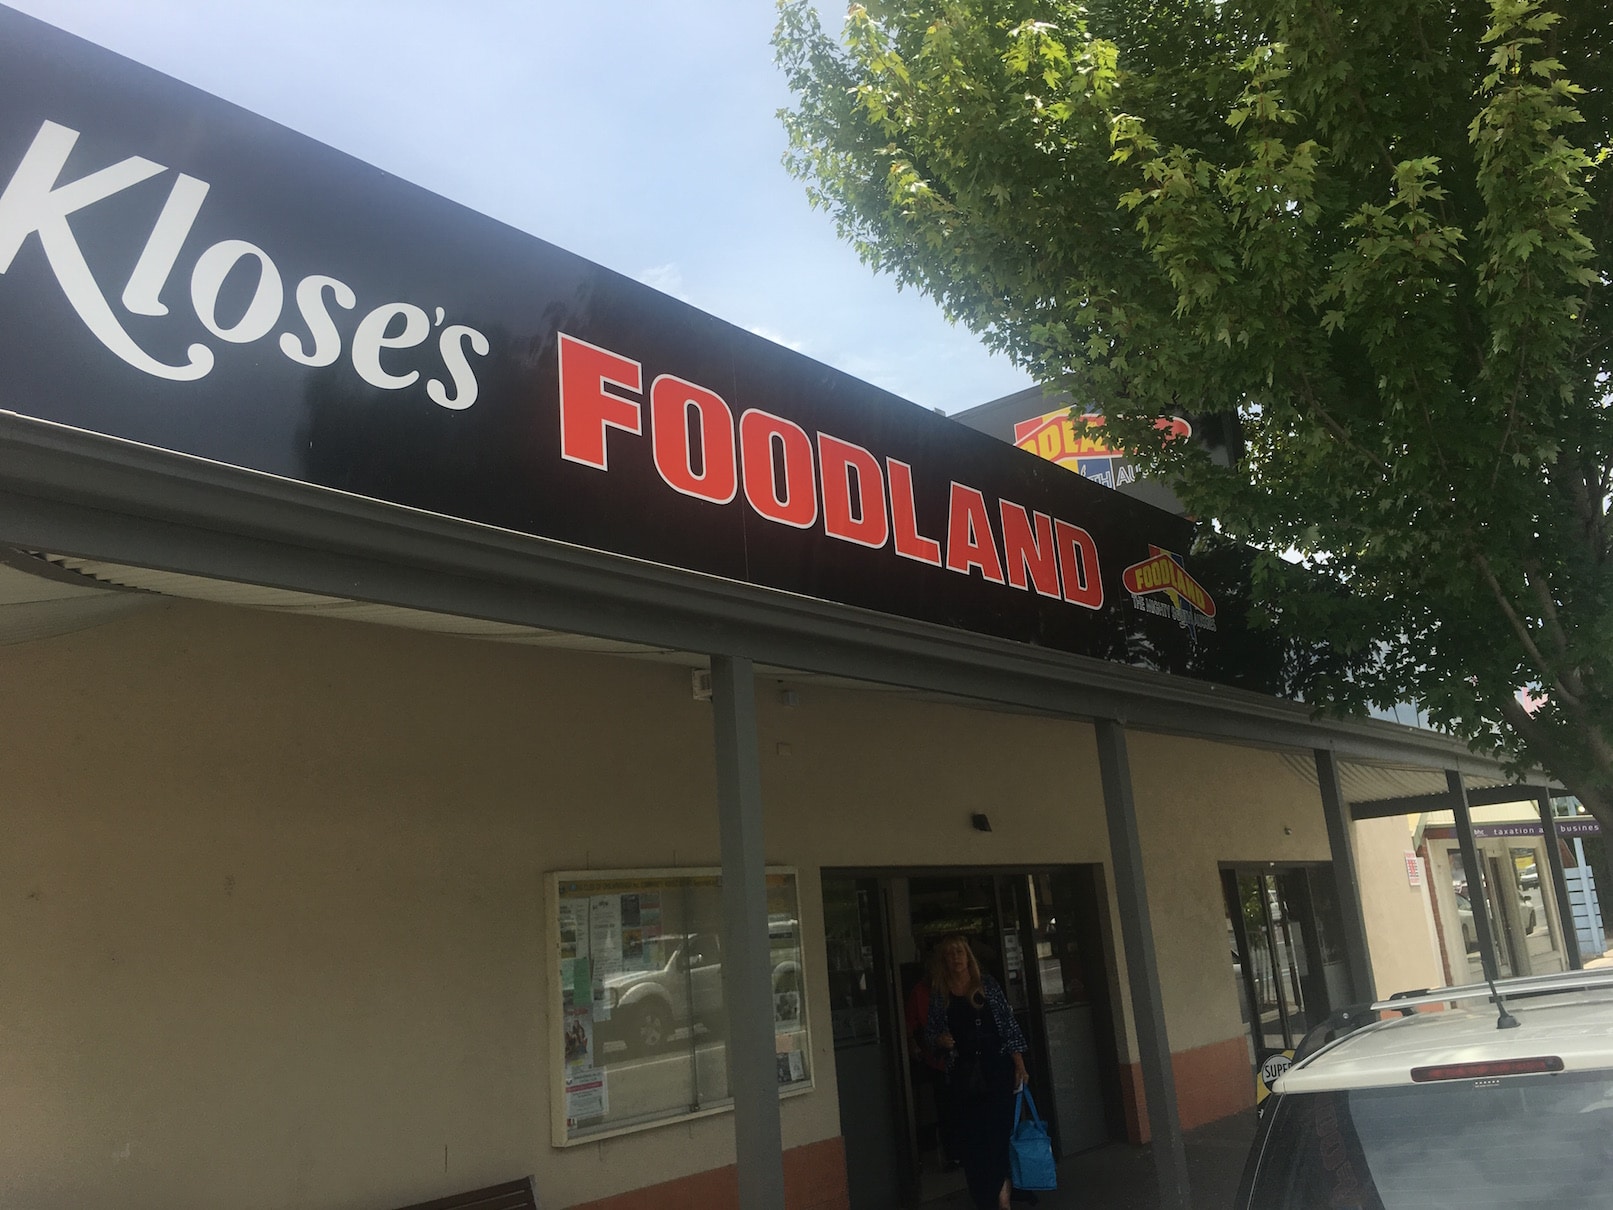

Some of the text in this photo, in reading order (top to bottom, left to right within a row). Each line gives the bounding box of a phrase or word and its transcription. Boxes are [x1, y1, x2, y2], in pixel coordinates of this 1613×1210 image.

[0, 119, 1104, 611] Klose's FOODLAND
[1134, 559, 1206, 611] FOODLAND
[1493, 827, 1535, 836] taxation
[1560, 824, 1600, 833] busines
[1264, 1062, 1292, 1078] SUPE
